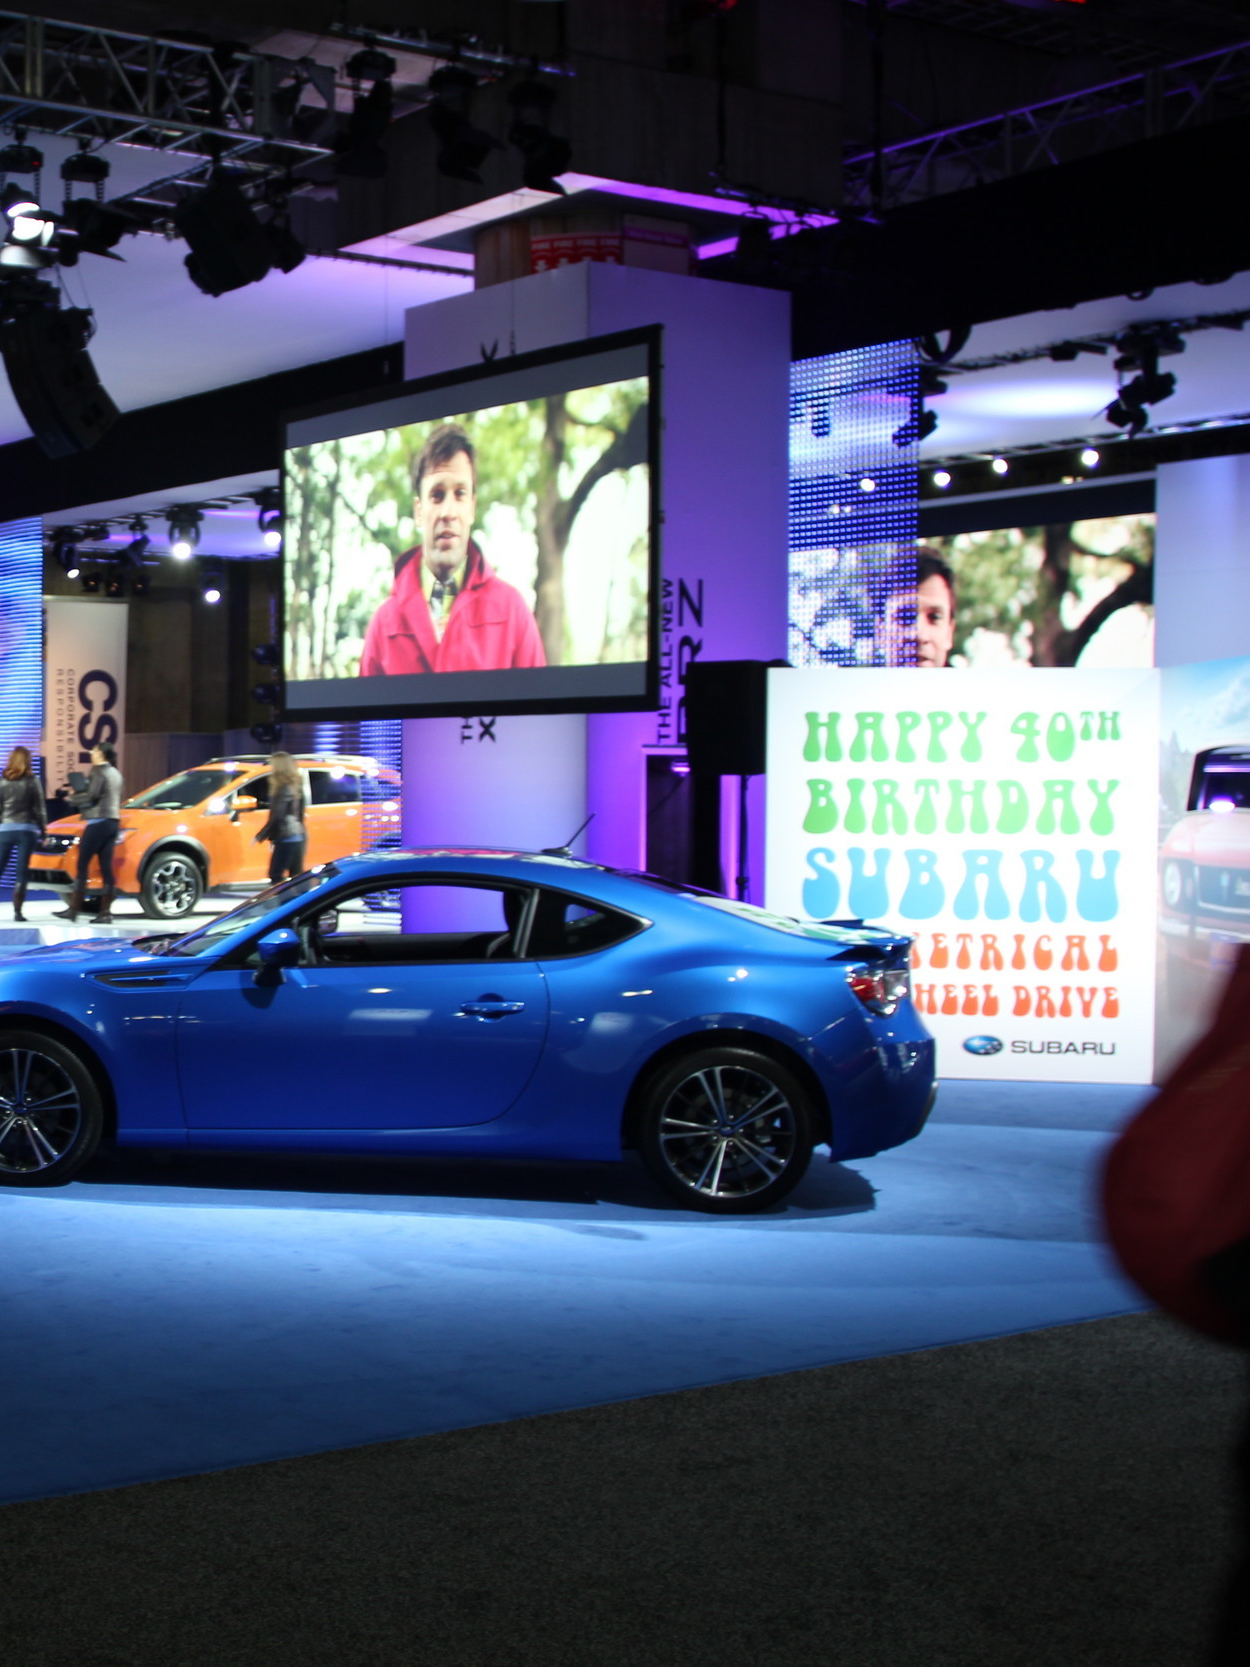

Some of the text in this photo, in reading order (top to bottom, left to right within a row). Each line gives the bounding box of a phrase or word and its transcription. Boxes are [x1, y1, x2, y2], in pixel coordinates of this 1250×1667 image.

[657, 578, 673, 744] THE ALL-NEW
[56, 668, 65, 782] RESPONSIBILIT
[67, 668, 76, 745] CORPORATE
[78, 669, 119, 765] CS
[460, 717, 473, 745] TH
[802, 711, 1122, 763] HAPPY 40TH
[802, 778, 1120, 837] BIRTHDAY
[802, 847, 1121, 923] SUBARU
[911, 932, 1119, 972] ETRICAL
[915, 983, 1119, 1019] HEEL DRIVE
[1011, 1039, 1115, 1056] SUBARU
